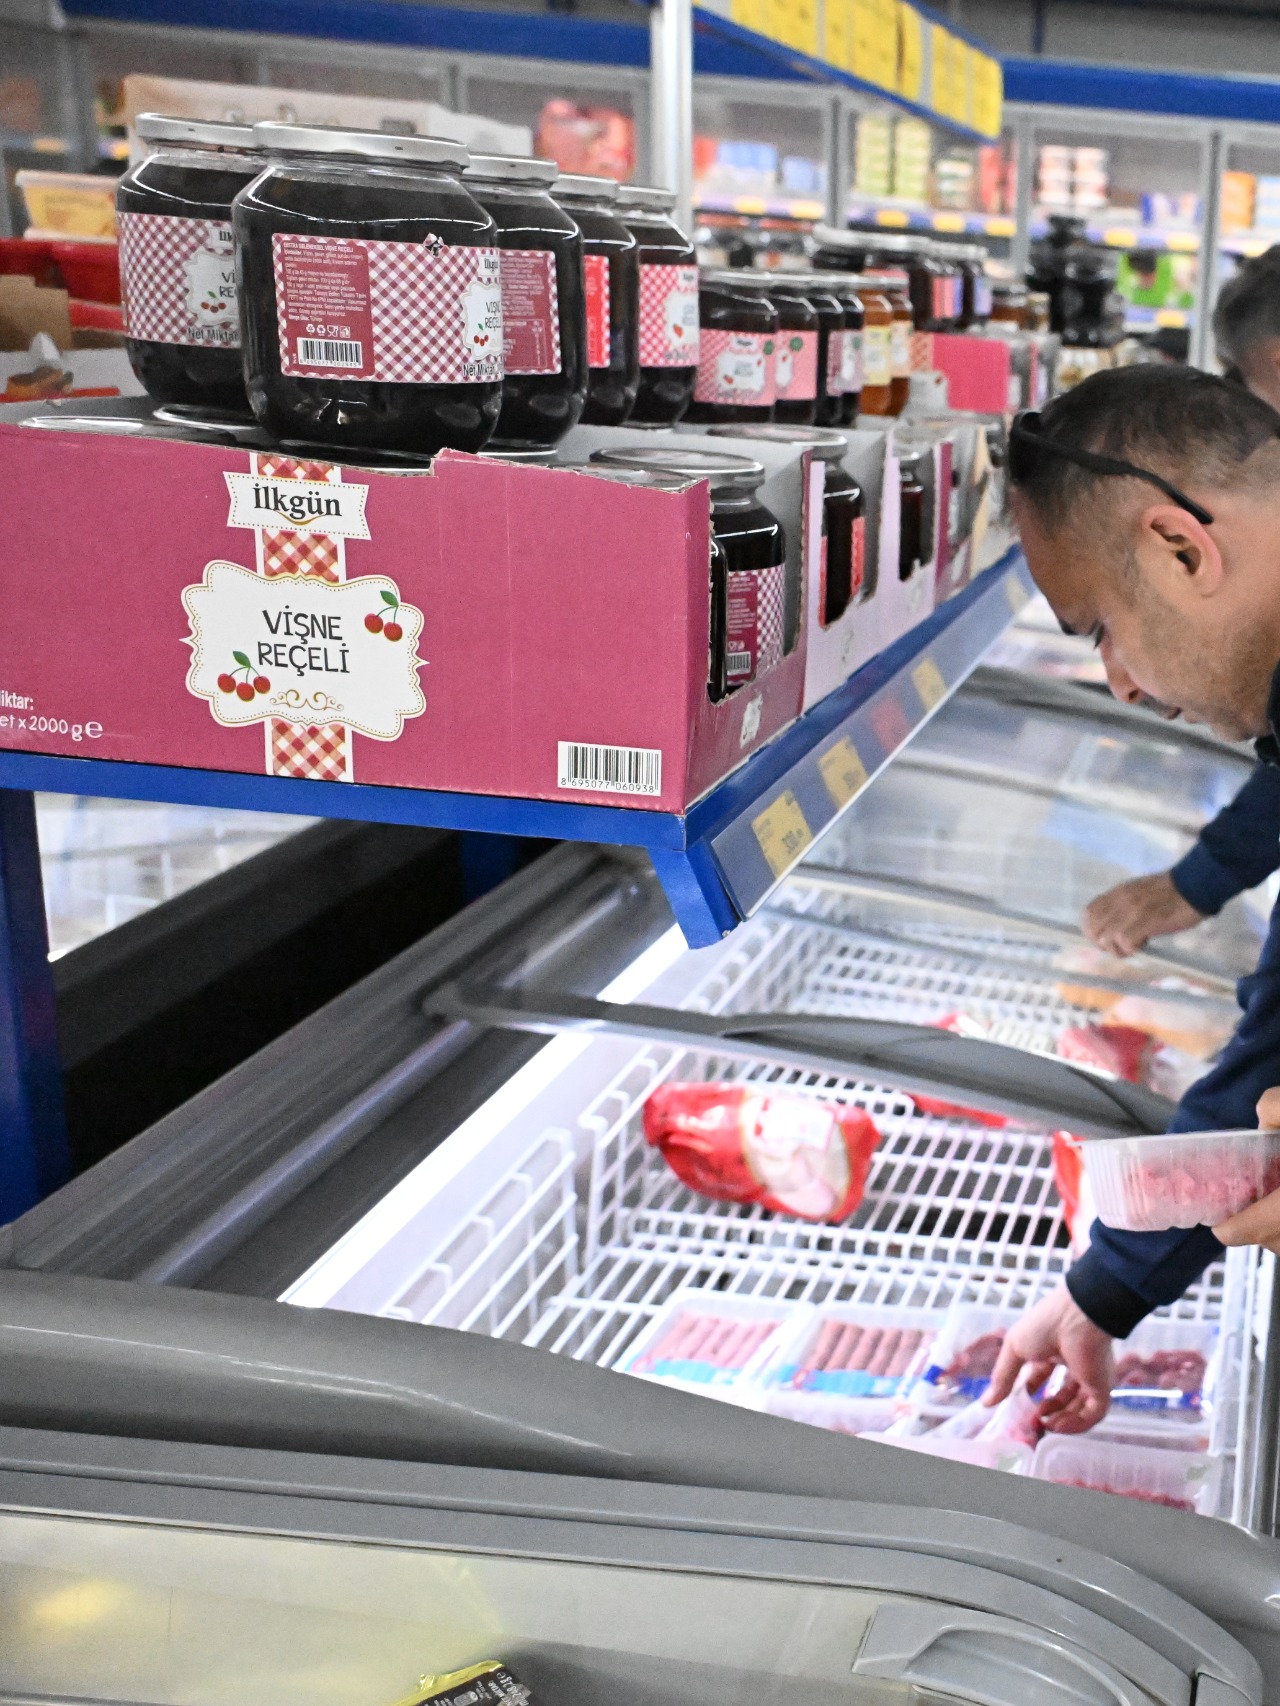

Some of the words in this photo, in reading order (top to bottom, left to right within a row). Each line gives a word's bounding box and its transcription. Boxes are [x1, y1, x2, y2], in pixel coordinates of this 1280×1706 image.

[188, 327, 204, 340] Net
[463, 363, 476, 376] Net
[252, 483, 342, 519] İlkgün
[262, 605, 343, 645] VİŞNE
[258, 642, 350, 676] REÇELİ
[0, 690, 34, 710] iktar:
[29, 715, 68, 734] 2000
